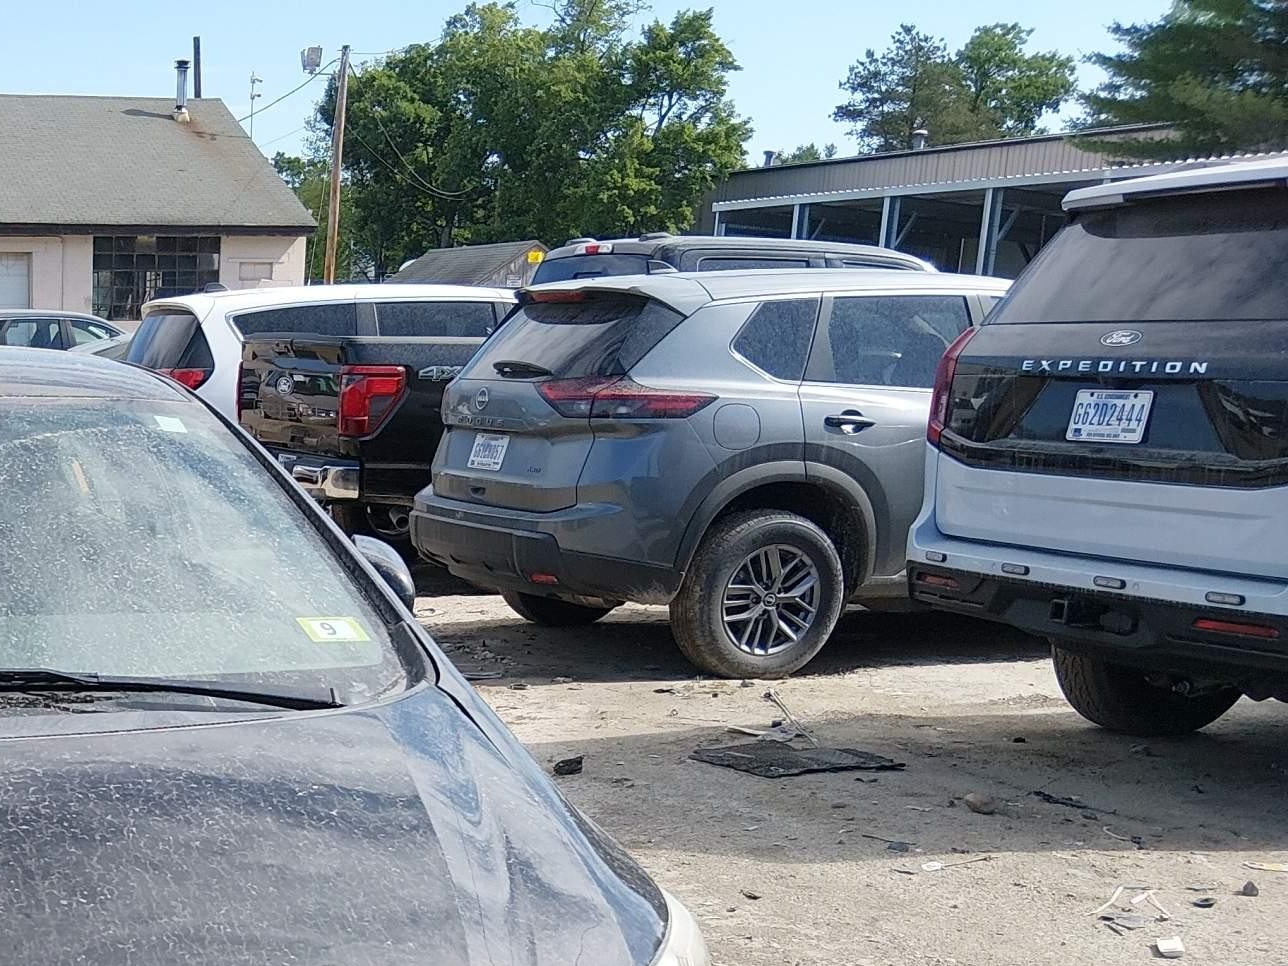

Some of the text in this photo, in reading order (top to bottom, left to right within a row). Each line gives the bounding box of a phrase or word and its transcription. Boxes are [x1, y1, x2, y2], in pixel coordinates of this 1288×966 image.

[418, 366, 463, 381] 4X
[1022, 359, 1209, 375] EXPEDITION
[320, 622, 336, 635] 9
